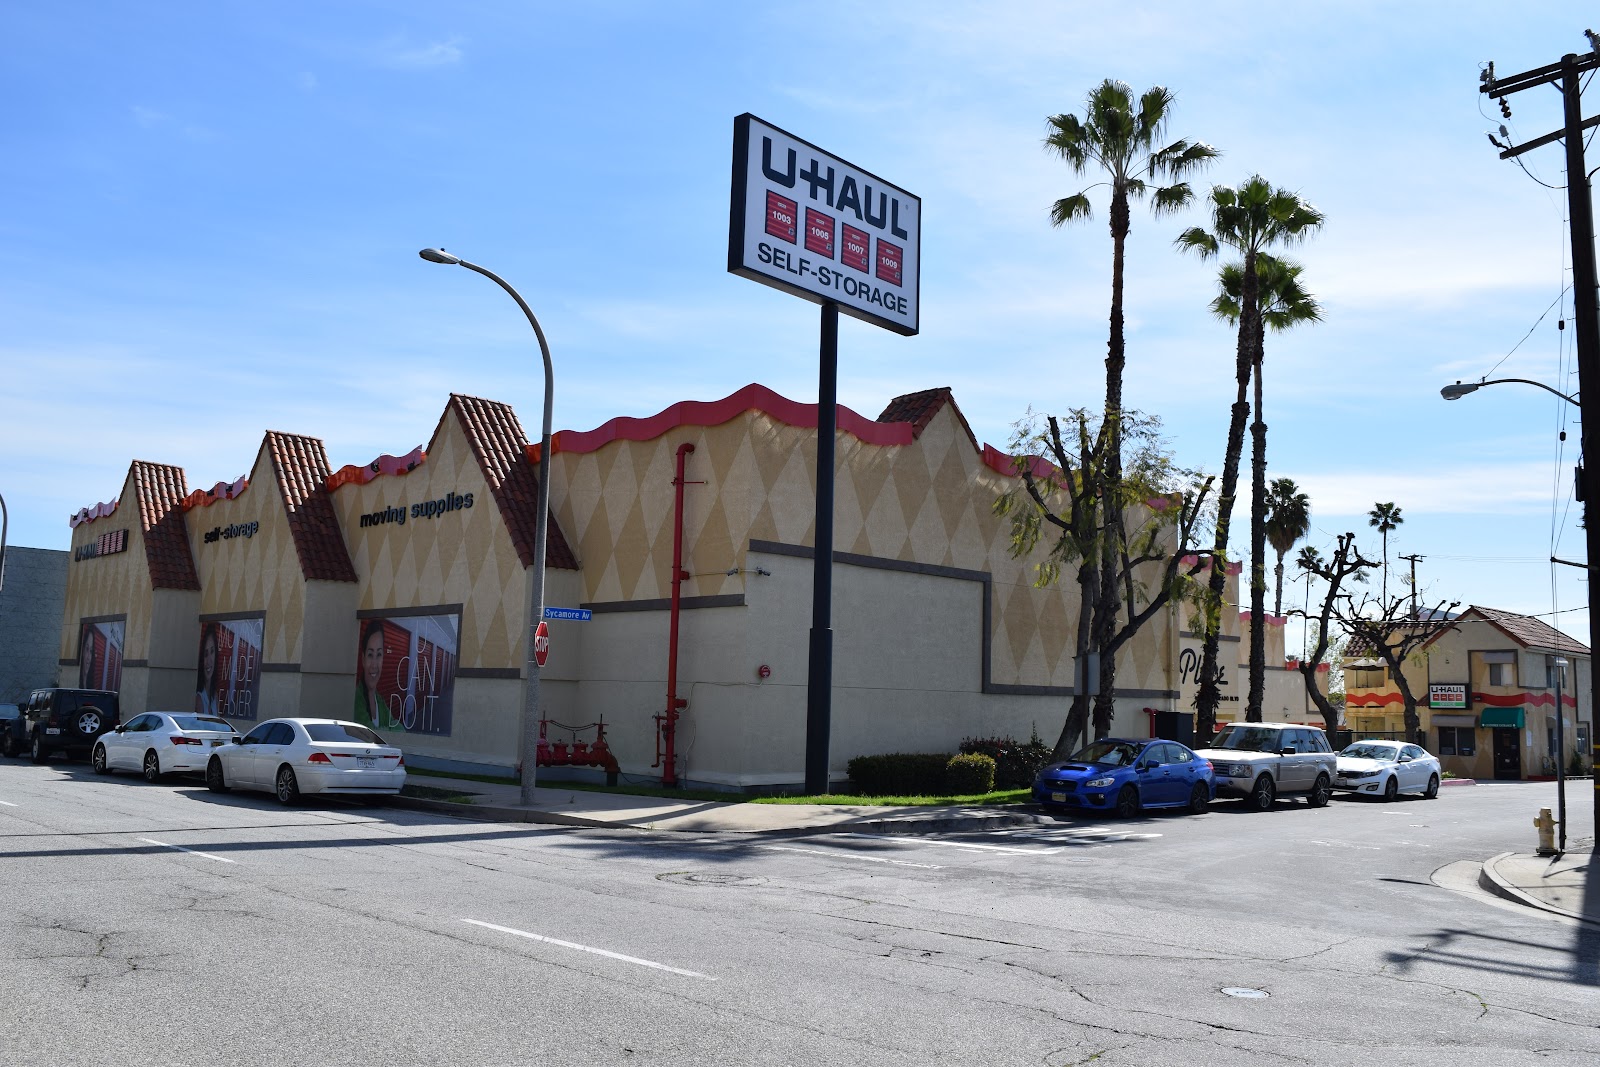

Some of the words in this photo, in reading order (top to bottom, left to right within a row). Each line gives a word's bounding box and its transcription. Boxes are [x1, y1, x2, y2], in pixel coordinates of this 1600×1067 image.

[762, 135, 907, 240] U-HAUL
[772, 210, 791, 225] 1003
[811, 226, 829, 240] 1005
[847, 242, 864, 255] 1007
[881, 257, 898, 269] 1009
[758, 242, 907, 316] SELF-STORAGE
[360, 505, 406, 528] moving
[411, 492, 473, 519] supplies
[204, 520, 259, 544] self-storage
[545, 608, 579, 619] Sycamore
[581, 611, 590, 620] Av
[535, 636, 549, 653] STOP
[221, 655, 253, 682] MADE
[397, 656, 436, 691] CAN
[1179, 647, 1228, 684] Ple
[388, 693, 417, 729] DO
[422, 695, 440, 732] IT.
